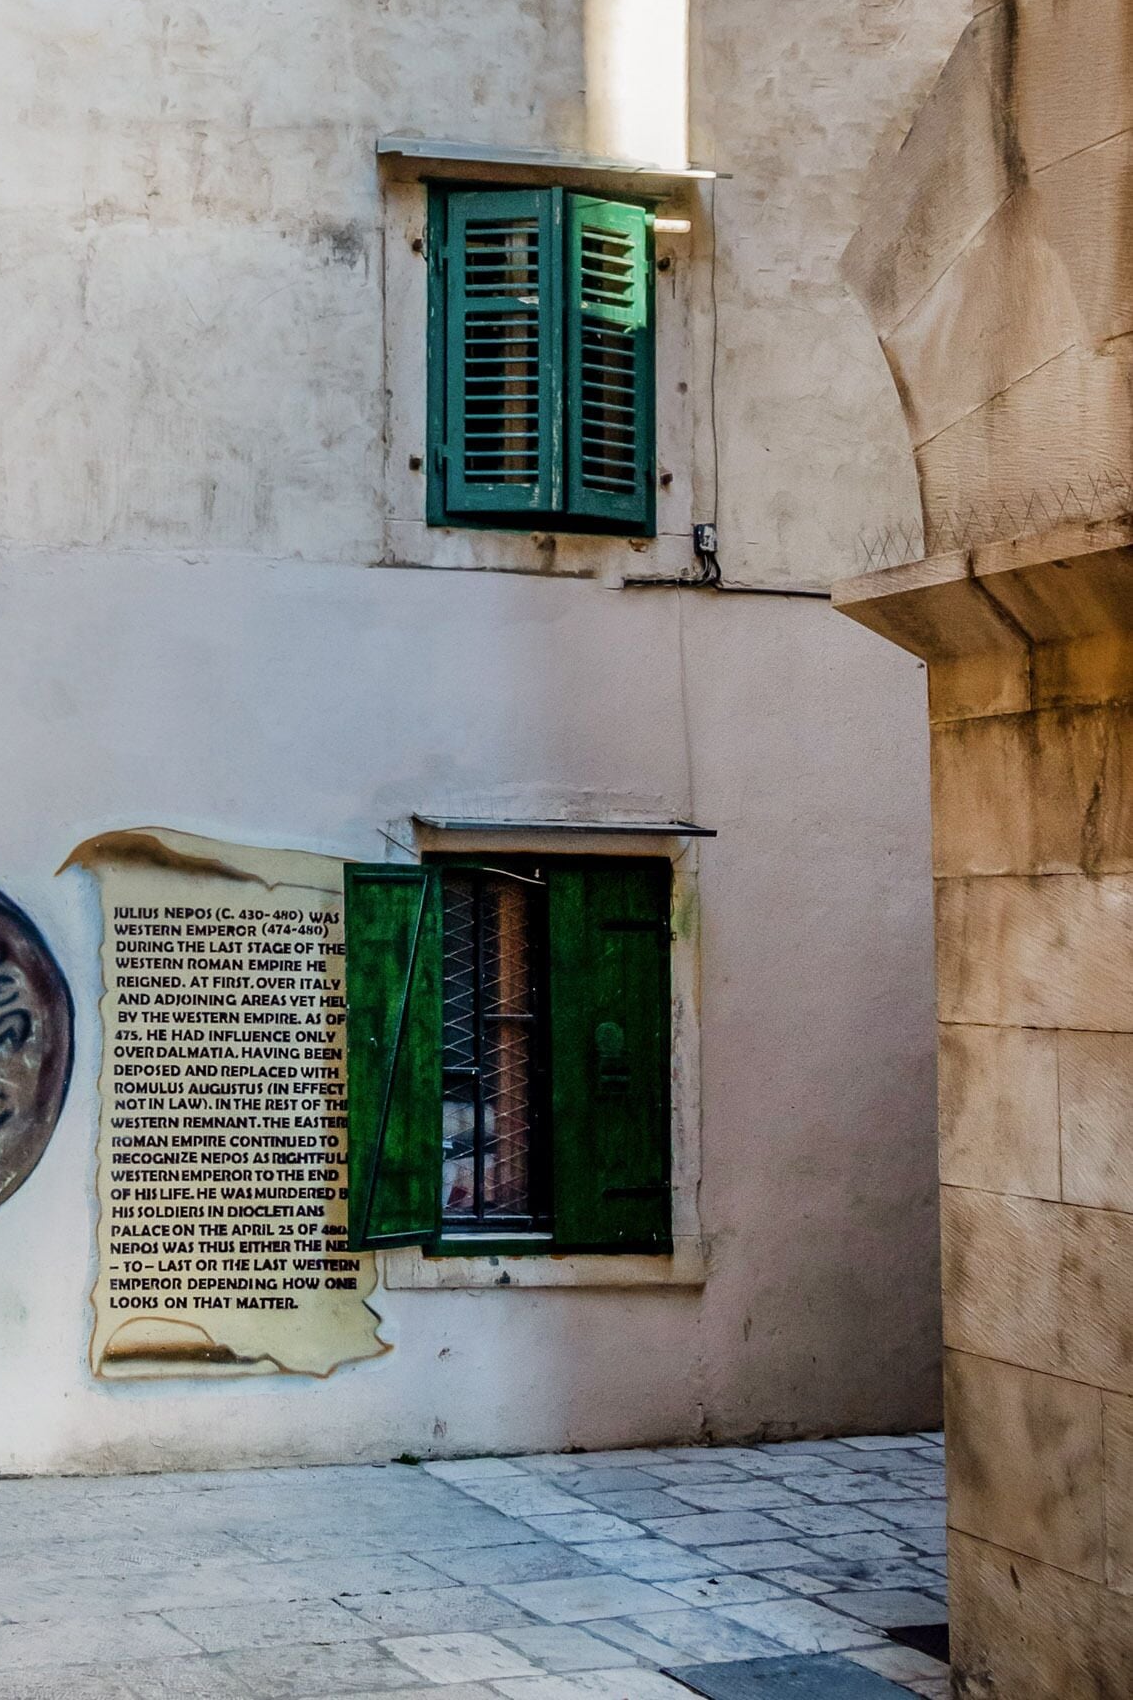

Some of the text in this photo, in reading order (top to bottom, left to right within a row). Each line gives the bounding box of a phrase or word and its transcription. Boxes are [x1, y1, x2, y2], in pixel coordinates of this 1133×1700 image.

[113, 906, 159, 920] JULIUS
[164, 906, 213, 920] NEPOS
[309, 910, 340, 925] WAS
[114, 923, 183, 937] WESTERN
[185, 923, 257, 937] EMPEROR
[116, 940, 347, 956] DURING THE LAST STAGE OF THE
[115, 956, 327, 973] WESTERN ROMAN EMPIRE HE
[189, 975, 209, 989] AT
[256, 976, 296, 990] OVER
[299, 977, 341, 991] ITALY
[117, 992, 347, 1009] AND ADJOINING AREAS YET HEL
[117, 1010, 139, 1024] BY
[141, 1011, 171, 1024] THE
[172, 1011, 240, 1024] WESTERN
[305, 1012, 322, 1025] AS
[325, 1012, 346, 1026] OF
[146, 1028, 167, 1042] HE
[171, 1029, 205, 1042] HAD
[209, 1029, 291, 1043] INFLUENCE
[295, 1030, 337, 1044] ONLY
[113, 1045, 155, 1059] OVER
[241, 1046, 301, 1060] HAVING
[303, 1047, 343, 1061] BEEN
[113, 1063, 339, 1080] DEPOSED AND REPLACED WITH
[114, 1081, 345, 1097] ROMULUS AUGUSTUS (IN EFFECT
[115, 1097, 147, 1111] NOT
[148, 1097, 165, 1110] IN
[215, 1097, 231, 1111] IN
[232, 1097, 261, 1111] THE
[265, 1098, 299, 1111] REST
[301, 1098, 321, 1111] OF
[111, 1116, 179, 1130] WESTERN
[262, 1116, 291, 1129] THE
[111, 1134, 339, 1148] ROMAN EMPIRE CONTINUED TO
[112, 1151, 347, 1166] RECOGNIZE NEPOS AS RIGHTFUL
[110, 1168, 339, 1183] WESTERN EMPEROR TO THE END
[110, 1187, 131, 1201] OF
[134, 1187, 158, 1201] HIS
[196, 1187, 217, 1200] HE
[220, 1187, 253, 1200] WAS
[254, 1186, 336, 1202] MURDERED
[338, 1187, 349, 1201] B
[111, 1206, 135, 1219] HIS
[137, 1205, 205, 1219] SOLDIERS
[207, 1205, 224, 1218] IN
[111, 1224, 171, 1237] PALACE
[172, 1223, 195, 1237] ON
[198, 1223, 228, 1237] THE
[231, 1223, 275, 1237] APRIL
[277, 1224, 295, 1236] 25
[297, 1223, 318, 1236] OF
[109, 1241, 159, 1255] NEPOS
[161, 1241, 195, 1254] WAS
[197, 1240, 236, 1254] THUS
[239, 1240, 291, 1254] EITHER
[293, 1239, 323, 1253] THE
[123, 1260, 143, 1273] TO
[157, 1259, 193, 1272] LAST
[195, 1259, 218, 1272] OR
[221, 1258, 250, 1272] THE
[253, 1258, 287, 1272] LAST
[292, 1258, 360, 1273] WESTERN
[109, 1276, 357, 1291] EMPEROR DEPENDING HOW ONE
[109, 1296, 159, 1309] LOOKS
[165, 1296, 188, 1309] ON
[193, 1296, 232, 1309] THAT
